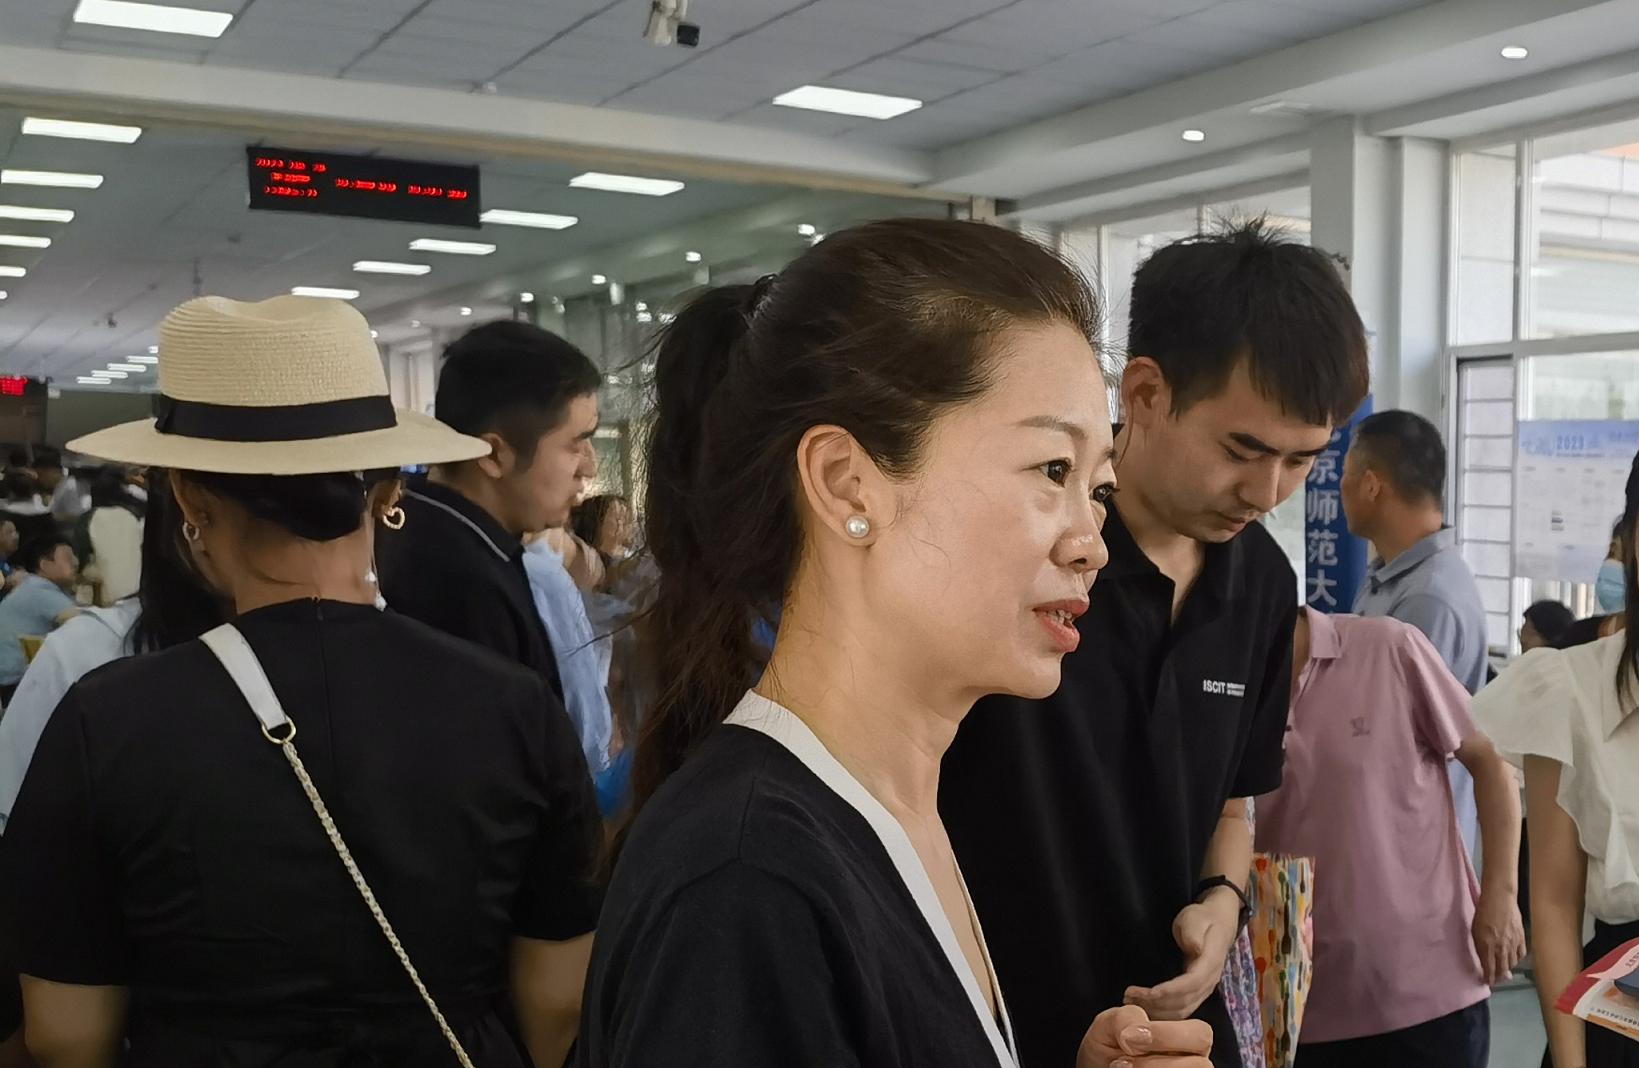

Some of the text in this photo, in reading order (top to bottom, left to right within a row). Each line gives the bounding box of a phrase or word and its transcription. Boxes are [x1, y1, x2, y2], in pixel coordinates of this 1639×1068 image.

[1306, 430, 1341, 608] 京师范大
[1203, 679, 1226, 695] ISCIT
